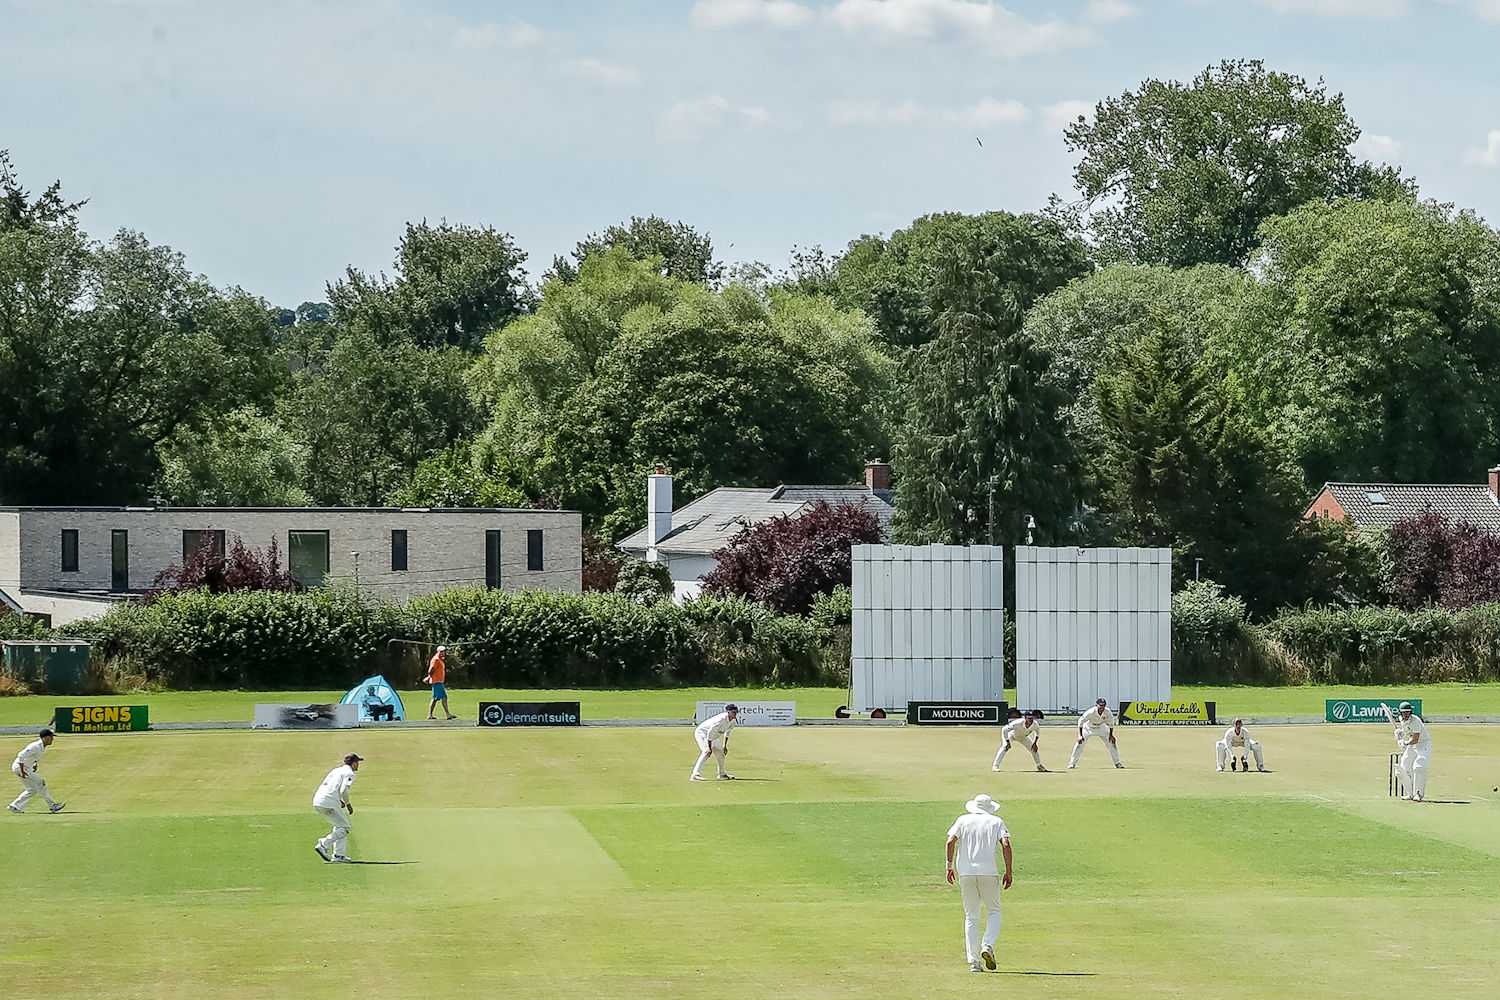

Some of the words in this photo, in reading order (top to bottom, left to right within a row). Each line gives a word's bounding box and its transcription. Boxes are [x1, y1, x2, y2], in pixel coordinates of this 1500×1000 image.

[737, 704, 764, 714] rtech
[932, 709, 985, 718] MOULDING
[1136, 702, 1201, 719] Vinyl-Installs
[72, 707, 131, 723] SIGNS
[488, 711, 499, 719] es
[504, 712, 576, 723] elementsuite
[84, 723, 114, 731] Motion
[118, 722, 131, 731] Ltd
